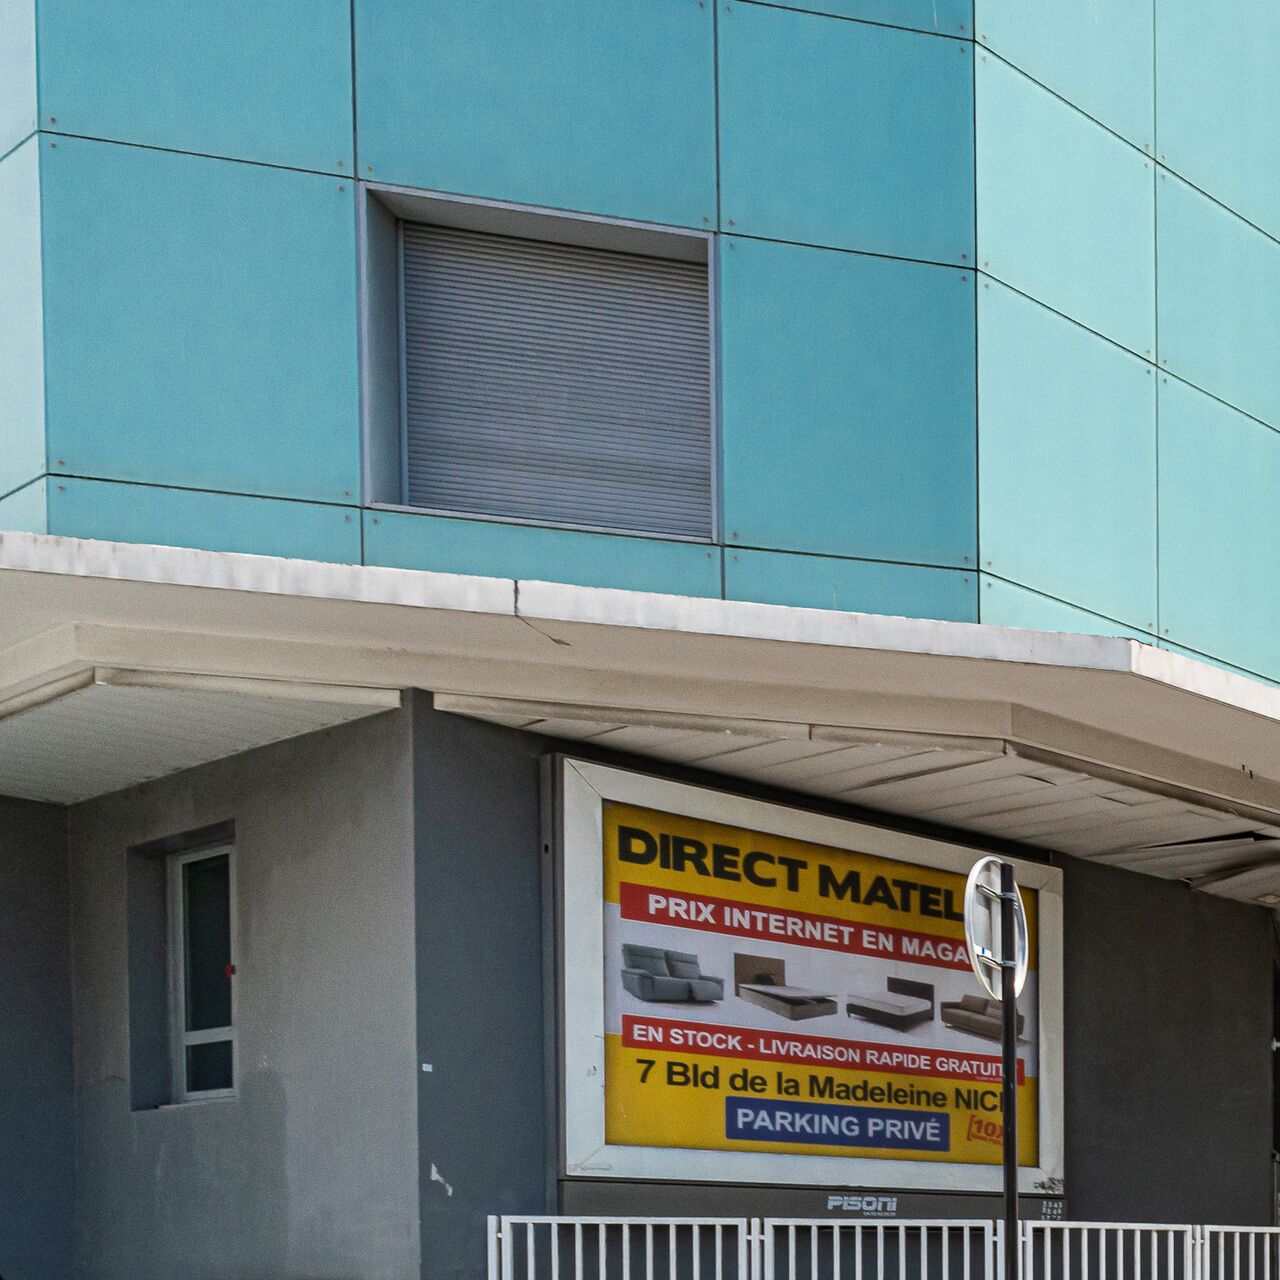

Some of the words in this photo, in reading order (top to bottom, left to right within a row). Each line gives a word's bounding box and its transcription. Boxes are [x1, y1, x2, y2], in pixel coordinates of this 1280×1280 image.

[618, 825, 808, 893] DIRECT
[819, 864, 966, 922] MATEL
[648, 894, 716, 924] PRIX
[724, 906, 855, 945] INTERNET
[862, 929, 895, 953] EN
[902, 936, 970, 965] MAGA
[633, 1024, 664, 1043] EN
[669, 1028, 743, 1051] STOCK
[759, 1038, 861, 1063] LIVRAISON
[866, 1049, 931, 1071] RAPIDE
[936, 1058, 1004, 1077] GRATUIT
[636, 1058, 656, 1084] 7
[666, 1060, 720, 1089] Bld
[728, 1068, 768, 1093] de
[776, 1071, 800, 1097] la
[809, 1074, 947, 1108] Madeleine
[955, 1087, 1005, 1112] NIC
[737, 1108, 860, 1137] PARKING
[867, 1117, 941, 1142] PRIVÉ
